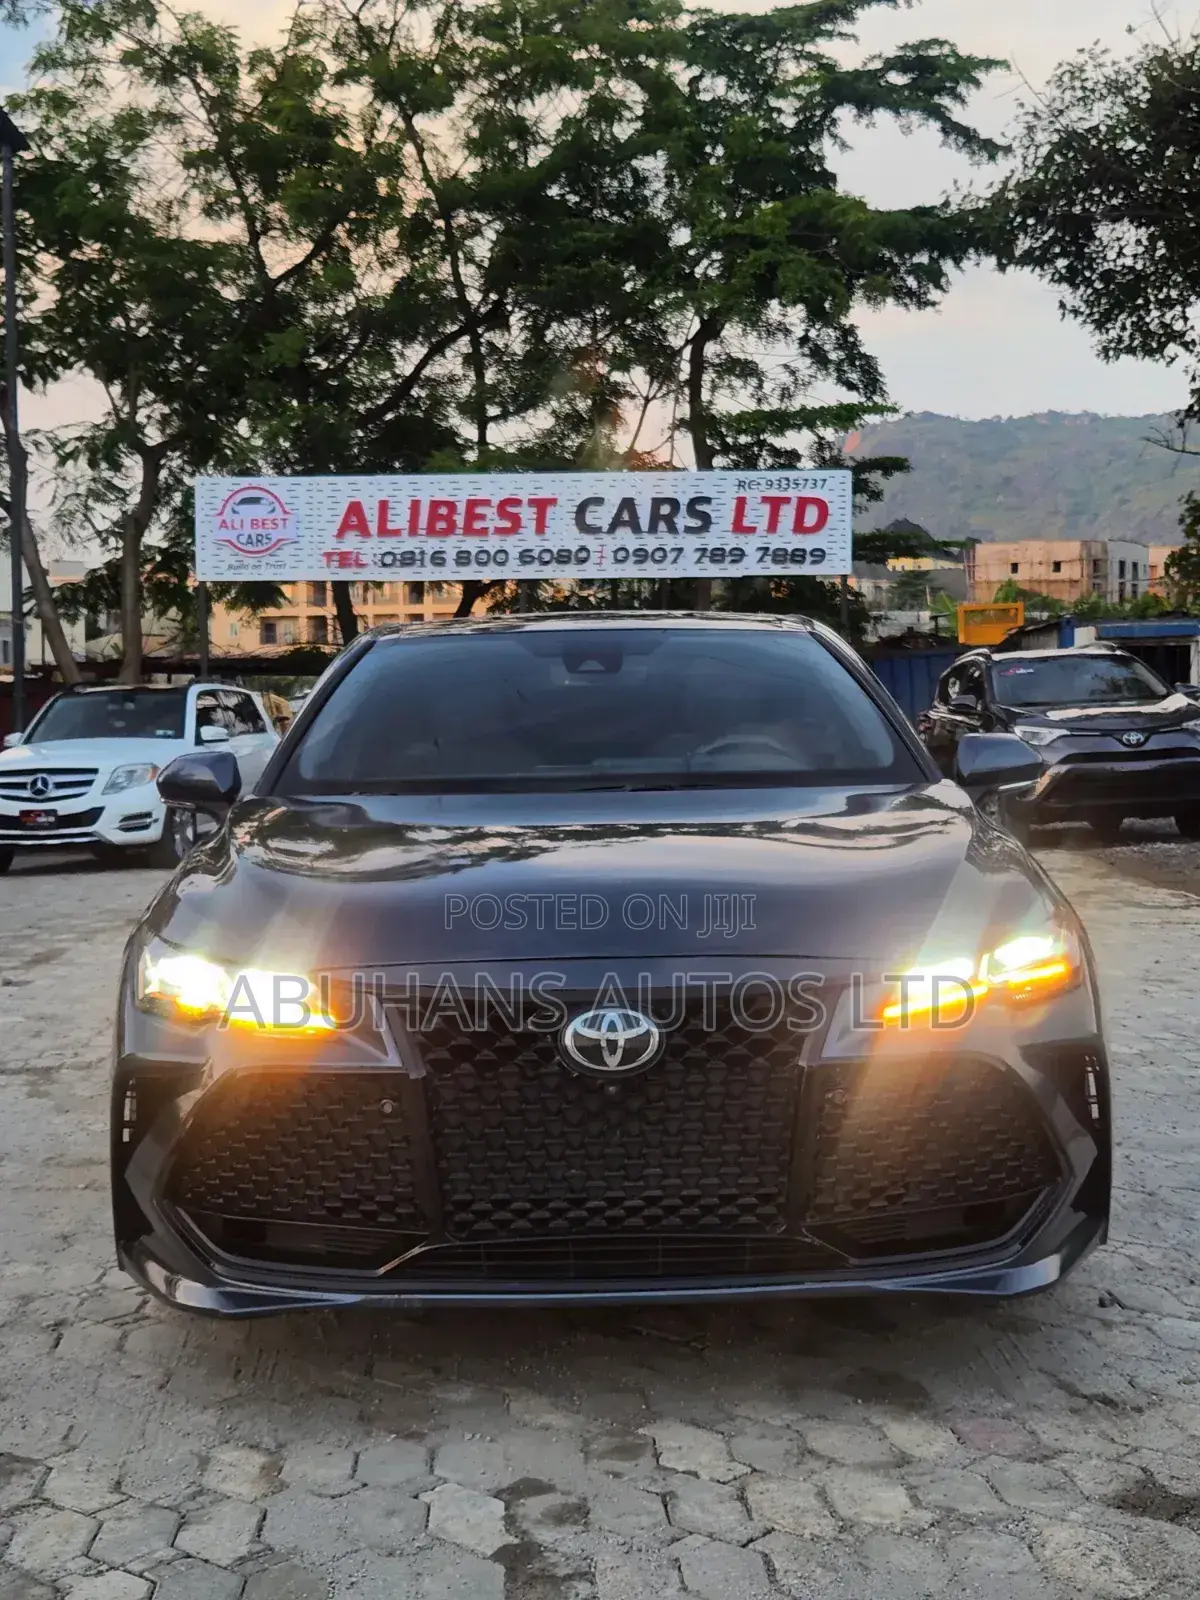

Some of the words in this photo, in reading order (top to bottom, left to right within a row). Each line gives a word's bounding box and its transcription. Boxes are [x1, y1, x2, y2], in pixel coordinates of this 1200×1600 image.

[218, 518, 244, 530] ALI
[250, 518, 288, 530] BEST
[335, 498, 557, 539] ALIBEST
[574, 496, 713, 535] CARS
[731, 496, 829, 535] LTD
[236, 533, 273, 547] CARS
[380, 550, 447, 567] 0816
[454, 549, 510, 567] 800
[518, 548, 591, 566] 6080
[613, 547, 684, 565] 0907
[693, 547, 746, 565] 789
[756, 546, 826, 565] 7889
